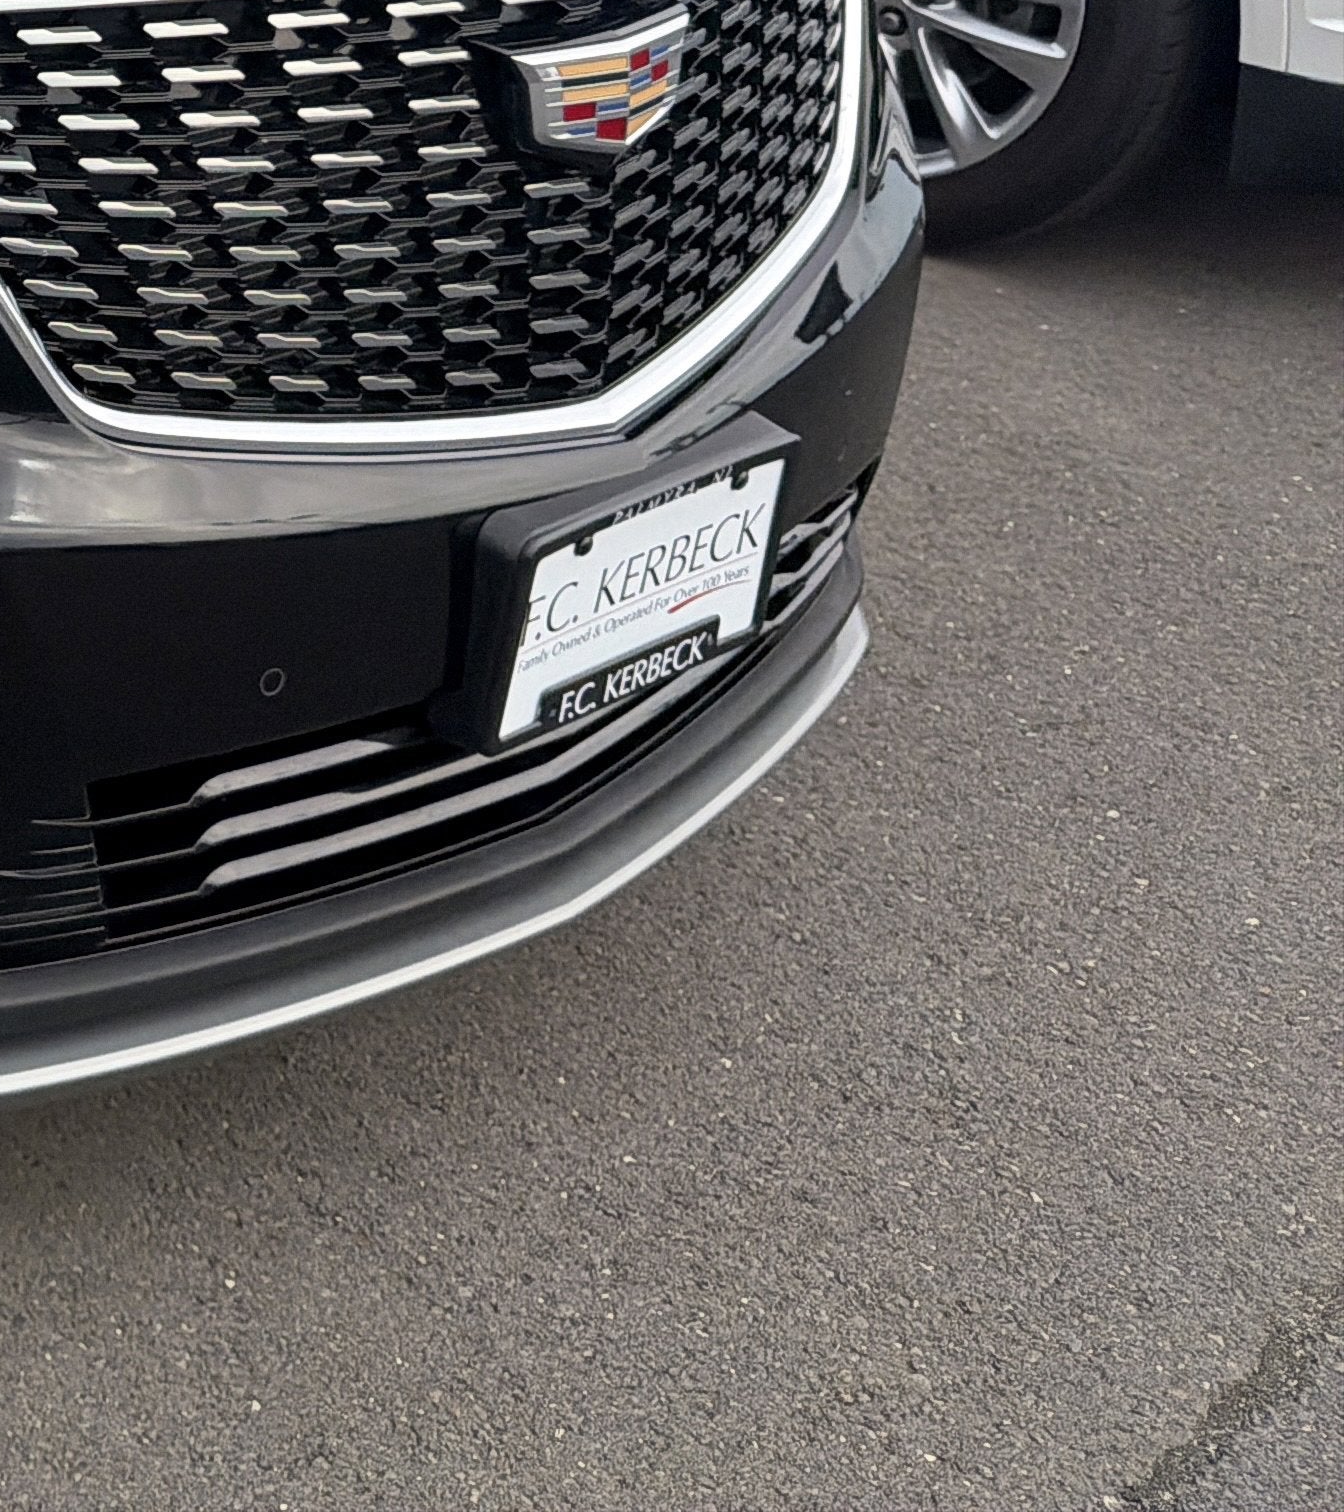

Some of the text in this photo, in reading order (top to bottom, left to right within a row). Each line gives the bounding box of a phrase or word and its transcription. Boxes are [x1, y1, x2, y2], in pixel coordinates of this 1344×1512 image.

[520, 502, 766, 647] F.C. KERBECK
[552, 627, 592, 657] Owned
[592, 624, 601, 640] &
[604, 599, 653, 635] Operated
[654, 595, 672, 611] For
[673, 584, 700, 603] Over
[702, 575, 721, 591] 100
[723, 565, 750, 583] Years
[558, 631, 708, 724] F.C. KERBECK
